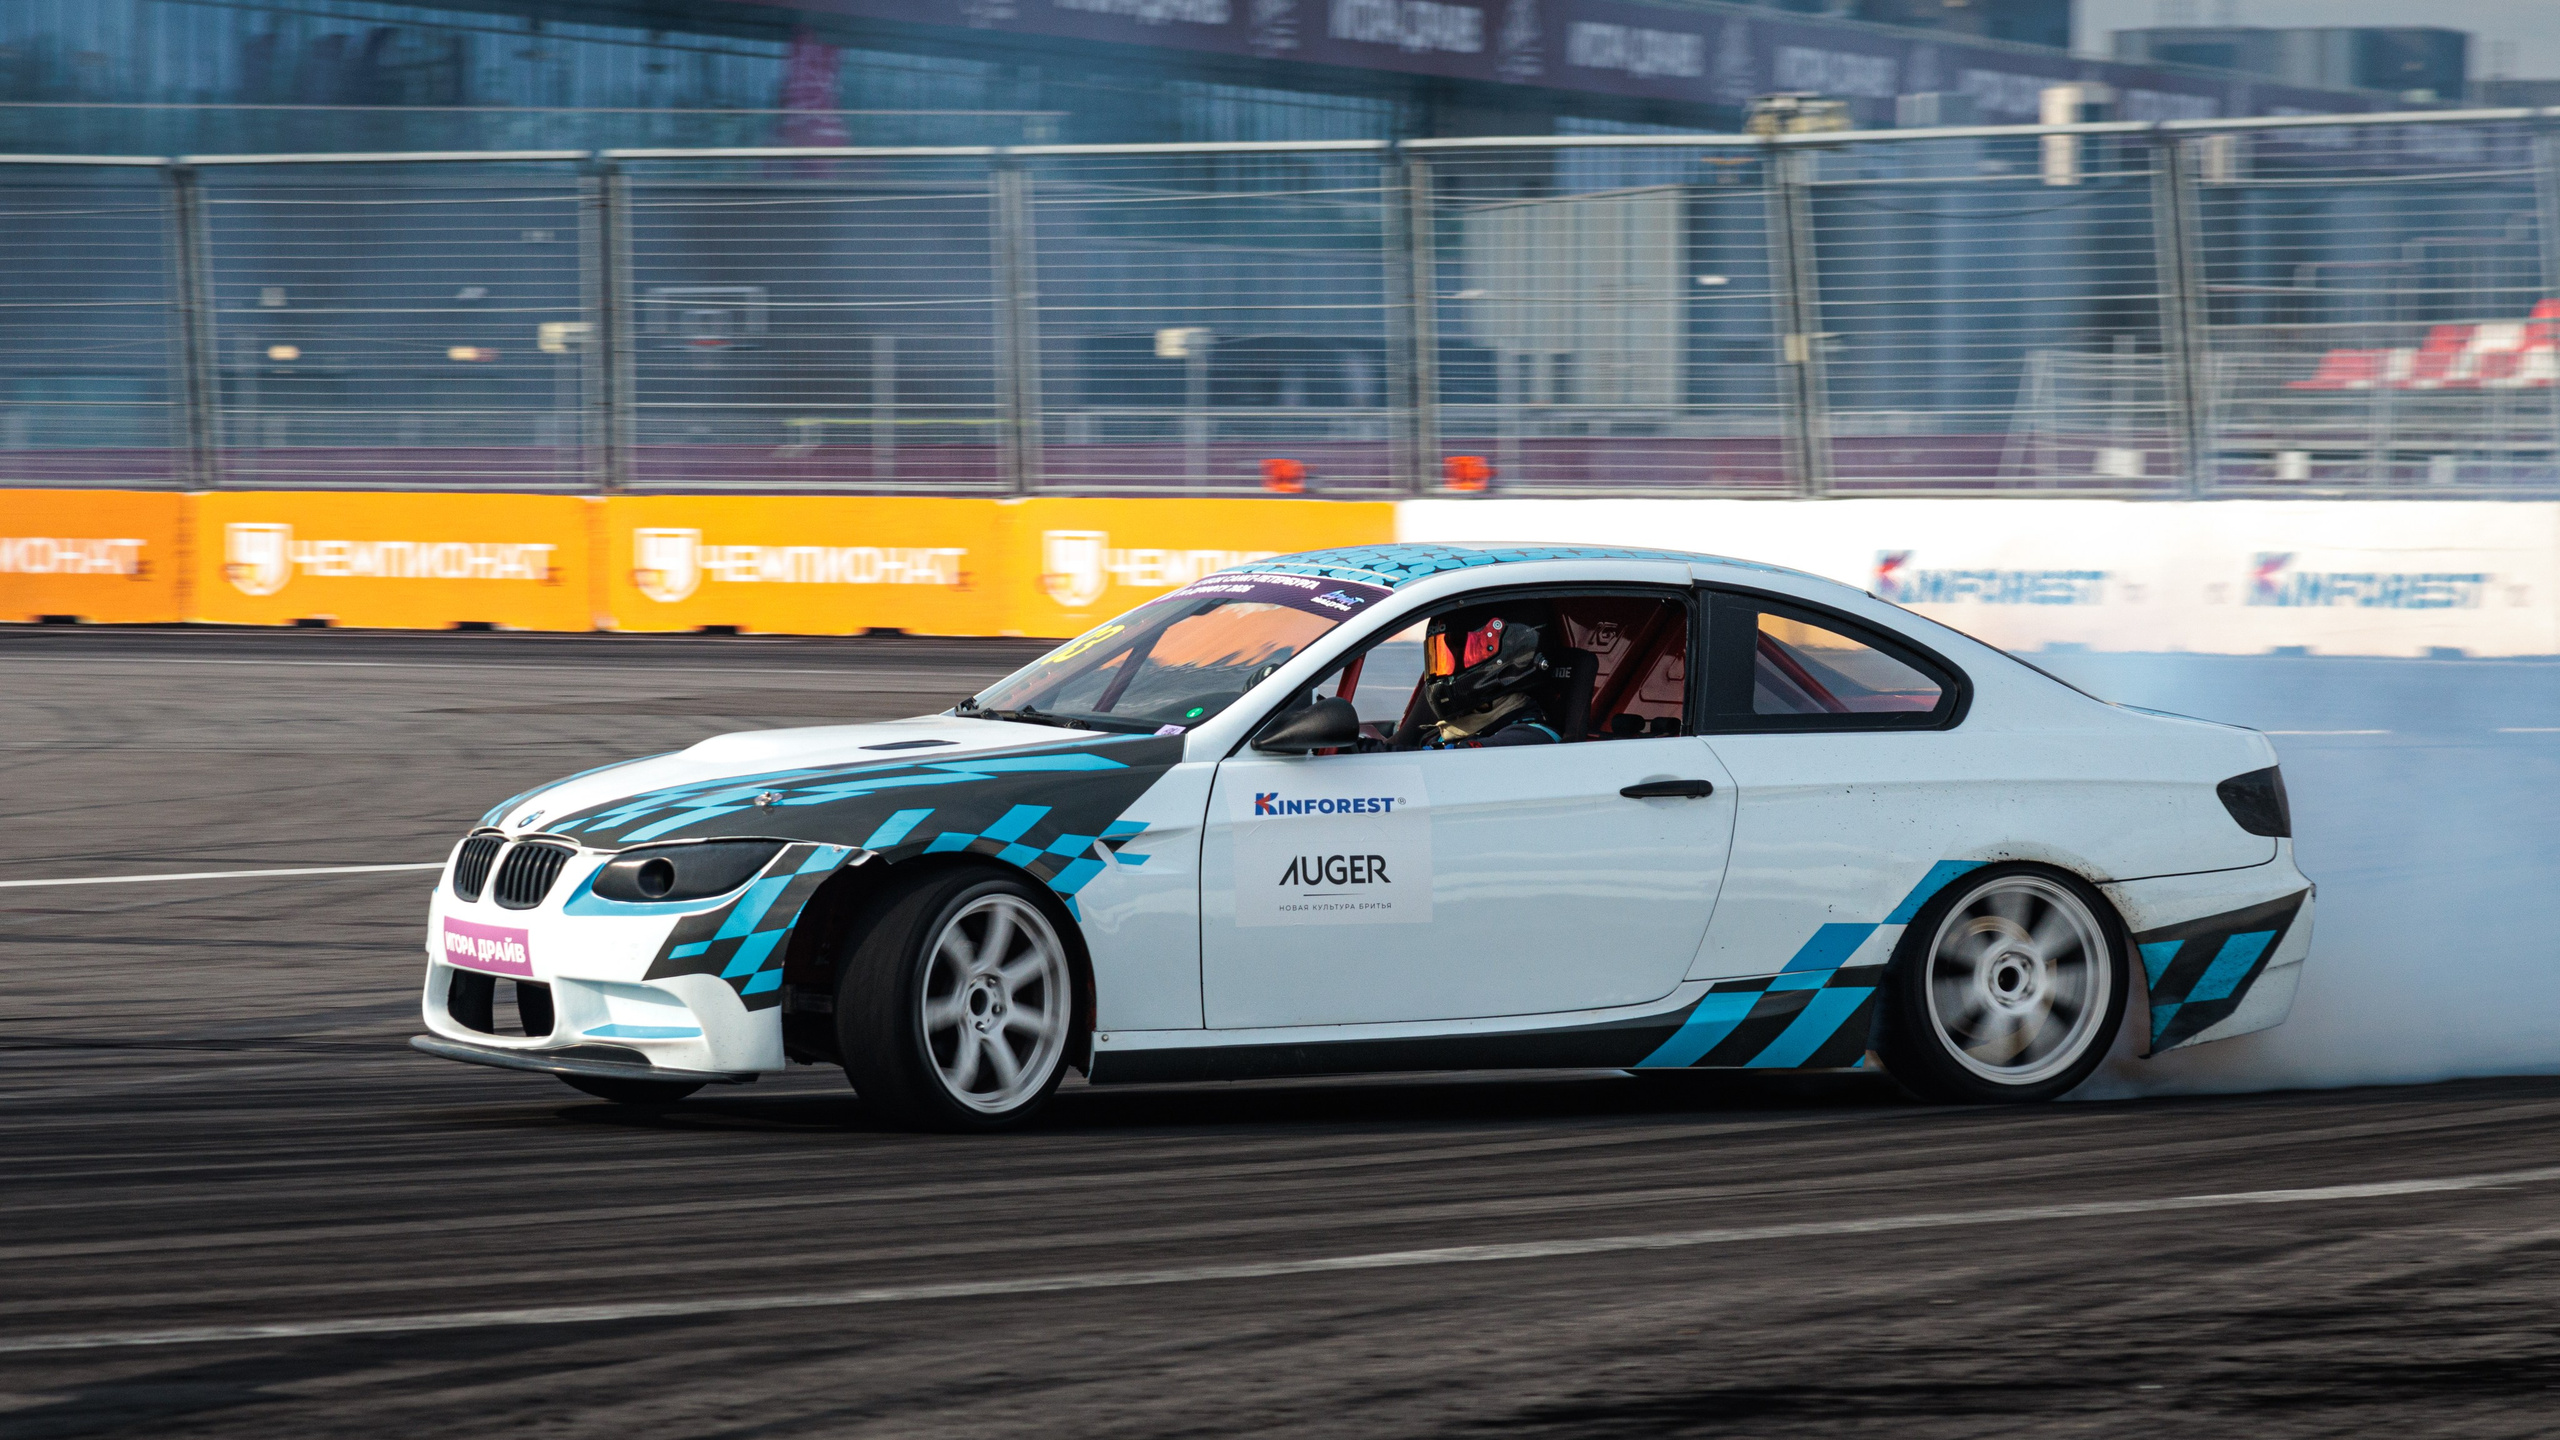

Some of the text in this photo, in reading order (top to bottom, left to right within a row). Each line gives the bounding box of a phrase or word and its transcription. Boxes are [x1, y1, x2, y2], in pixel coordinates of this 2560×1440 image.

[287, 539, 557, 579] ЧЕМПИОНАТ
[697, 545, 967, 585] ЧЕМПИОНАТ
[1278, 854, 1392, 886] AUGER
[1279, 902, 1392, 912] НОВАЯ КУЛЬТУРА БРИТЬЯ
[445, 931, 526, 963] ИГОРА ДРАЙВ
